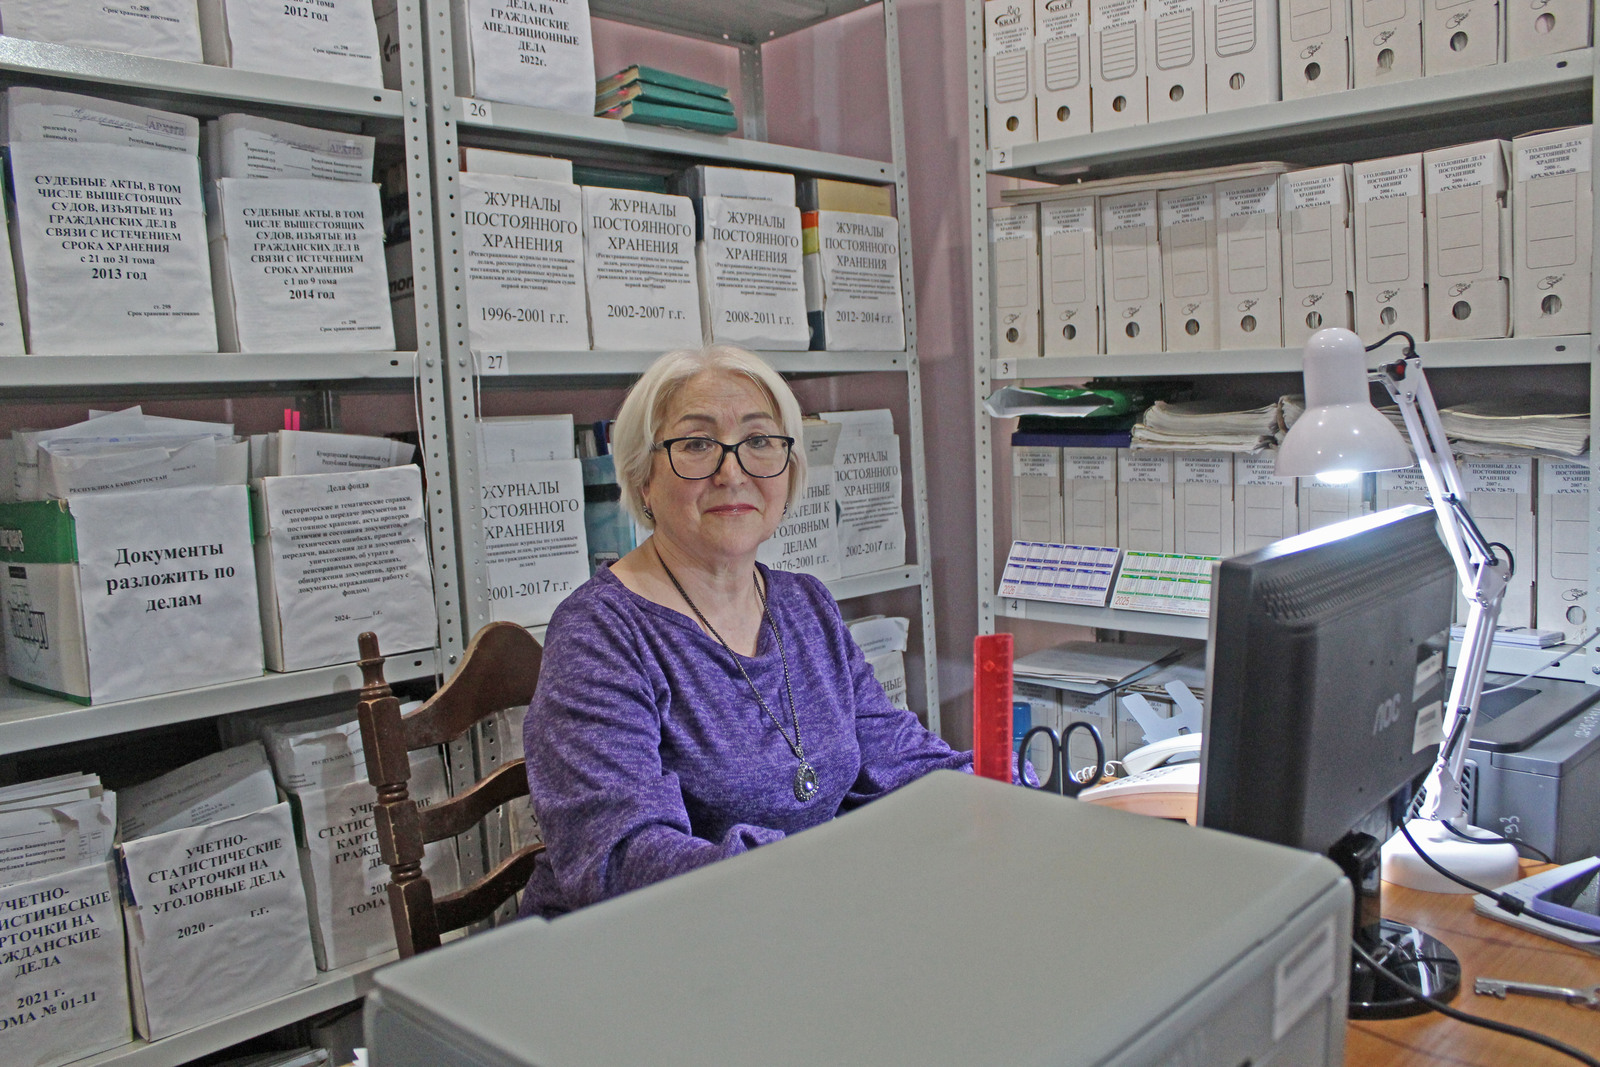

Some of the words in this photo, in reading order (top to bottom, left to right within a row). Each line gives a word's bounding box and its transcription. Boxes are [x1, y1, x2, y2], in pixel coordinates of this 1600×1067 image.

[284, 5, 308, 18] 2012
[312, 12, 328, 22] год
[540, 4, 553, 14] НА
[1050, 2, 1073, 12] KRAFT
[491, 8, 570, 30] ГРАЖДАНСКИЕ
[999, 17, 1021, 27] KRAFT
[482, 22, 579, 46] АПЕЛЛЯЦИОННЫЕ
[518, 41, 546, 53] ДЕЛА
[520, 54, 546, 66] 2022г.
[471, 103, 486, 116] 26
[1000, 152, 1005, 163] 2
[35, 175, 107, 187] СУДЕБНЫЕ
[109, 179, 146, 190] АКТЫ,
[148, 183, 156, 191] В
[158, 184, 181, 193] ТОМ
[38, 189, 82, 198] ЧИСЛЕ
[86, 191, 181, 205] ВЫШЕСТОЯЩИХ
[484, 192, 560, 212] ЖУРНАЛЫ
[52, 202, 98, 212] СУДОВ,
[102, 204, 156, 215] ИЗЪЯТЫЕ
[160, 208, 172, 216] ИЗ
[304, 210, 333, 218] АКТЫ,
[610, 198, 676, 217] ЖУРНАЛЫ
[50, 215, 142, 226] ГРАЖДАНСКИХ
[146, 219, 167, 228] ДЕЛ
[246, 220, 280, 228] ЧИСЛЕ
[284, 221, 364, 230] ВЫШЕСТОЯЩИХ
[466, 211, 577, 234] ПОСТОЯННОГО
[593, 216, 691, 236] ПОСТОЯННОГО
[728, 211, 785, 229] ЖУРНАЛЫ
[46, 228, 86, 237] СВЯЗИ
[90, 229, 98, 237] С
[102, 230, 181, 240] ИСТЕЧЕНИЕМ
[256, 232, 294, 240] СУДОВ,
[297, 232, 342, 240] ИЗЪЯТЫЕ
[712, 226, 798, 247] ПОСТОЯННОГО
[836, 222, 884, 238] ЖУРНАЛЫ
[62, 241, 104, 250] СРОКА
[107, 242, 169, 252] ХРАНЕНИЯ
[254, 244, 330, 252] ГРАЖДАНСКИХ
[333, 244, 351, 252] ДЕЛ
[483, 234, 562, 252] ХРАНЕНИЯ
[608, 237, 678, 254] ХРАНЕНИЯ
[825, 238, 896, 255] ПОСТОЯННОГО
[89, 254, 98, 262] 21
[118, 255, 128, 263] 31
[726, 248, 787, 264] ХРАНЕНИЯ
[837, 255, 886, 270] ХРАНЕНИЯ
[92, 268, 121, 279] 2013
[127, 272, 147, 280] год
[264, 266, 298, 274] СРОКА
[290, 290, 314, 299] 2014
[482, 308, 544, 322] 1996-2001
[550, 314, 568, 323] г.г.
[608, 305, 664, 318] 2002-2007
[669, 310, 685, 319] г.г.
[726, 310, 775, 324] 2008-2011
[779, 316, 794, 325] г.г.
[836, 310, 858, 322] 2012-
[861, 312, 879, 322] 2014
[488, 356, 502, 369] 27
[1003, 362, 1008, 374] 3
[843, 451, 888, 464] ЖУРНАЛЫ
[844, 482, 890, 496] ХРАНЕНИЯ
[783, 538, 817, 556] ДЕЛАМ
[846, 540, 882, 557] 2002-2017
[884, 542, 896, 550] г.г.
[114, 544, 223, 567] Документы
[817, 555, 829, 564] г.г.
[106, 569, 209, 595] разложить
[215, 567, 234, 578] по
[553, 582, 572, 592] г.г.
[146, 594, 202, 613] делам
[1011, 600, 1018, 610] 4
[186, 835, 247, 857] УЧЕТНО-
[148, 838, 282, 883] СТАТИСТИЧЕСКИЕ
[169, 864, 246, 894] КАРТОЧКИ
[250, 860, 268, 871] НА
[153, 880, 246, 914] УГОЛОВНЫЕ
[250, 870, 285, 889] ДЕЛА
[250, 907, 269, 917] г.г.
[72, 914, 94, 928] НА
[178, 922, 205, 938] 2020
[16, 956, 61, 978] ДЕЛА
[18, 991, 48, 1009] 2021
[54, 989, 64, 997] г.
[41, 1005, 56, 1018] №
[61, 992, 96, 1010] 01-11
